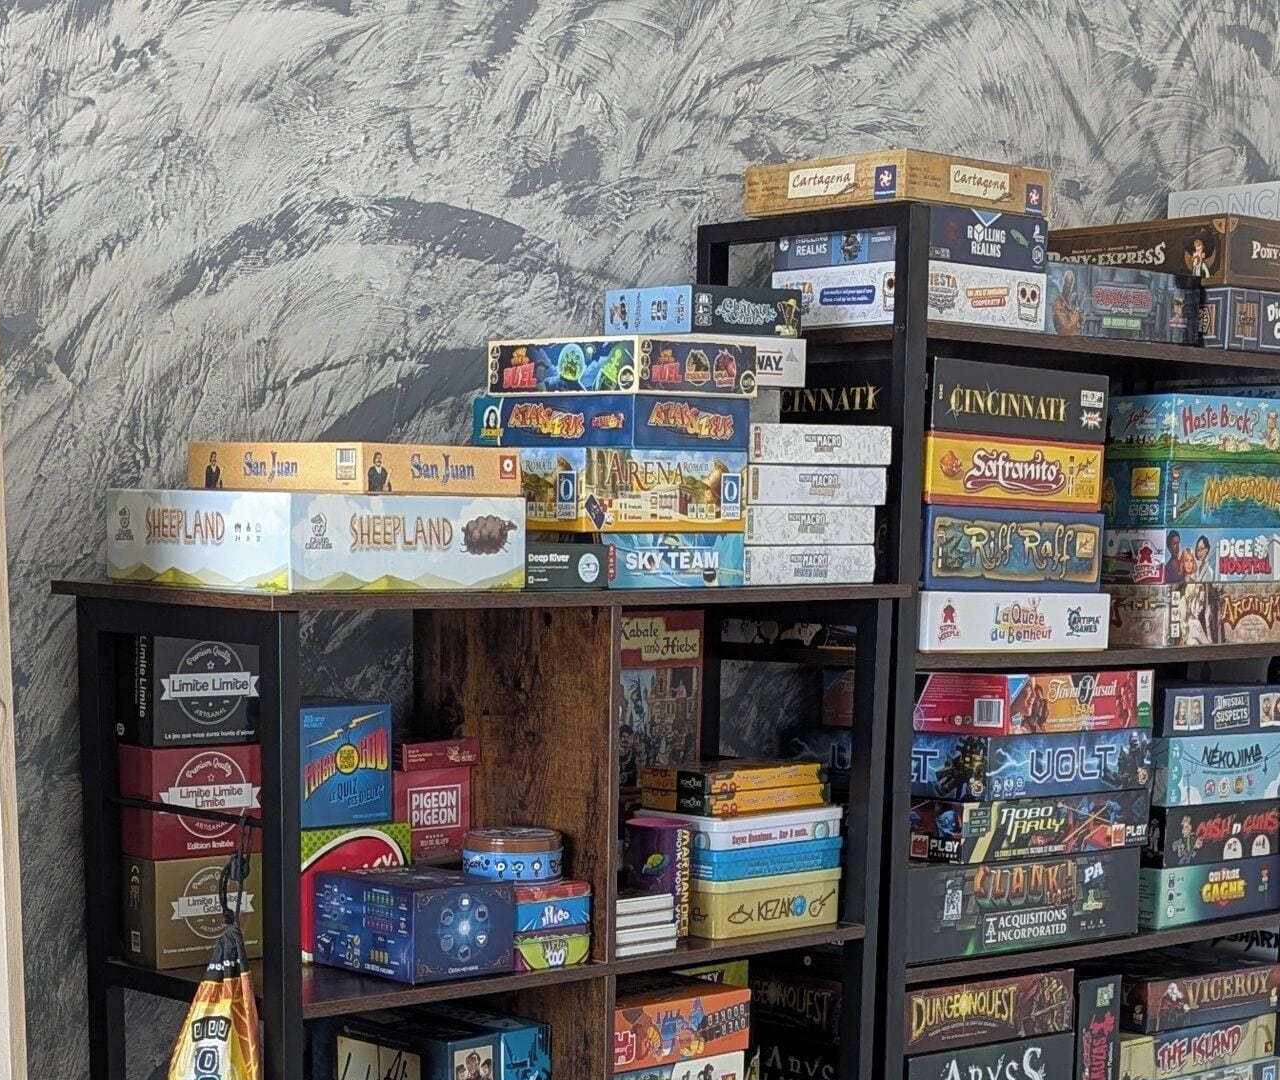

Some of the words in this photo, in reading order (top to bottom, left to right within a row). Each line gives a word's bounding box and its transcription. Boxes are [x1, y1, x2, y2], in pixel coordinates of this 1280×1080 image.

[792, 171, 852, 194] Cartagena
[952, 169, 1008, 193] Cartagena
[796, 243, 828, 256] REALMS
[970, 241, 1002, 258] REALMS
[503, 362, 537, 389] DUEL
[950, 387, 1070, 423] CINCINNATI
[1181, 406, 1218, 434] Haste
[1220, 407, 1260, 437] Bock?
[817, 434, 842, 448] MACRO
[244, 450, 269, 479] San
[269, 450, 299, 480] Juan
[410, 452, 439, 480] San
[439, 452, 476, 486] Juan
[525, 460, 546, 473] ROMA
[606, 451, 687, 492] ARENA
[683, 461, 703, 473] ROMA
[972, 448, 1062, 486] Safranito
[812, 474, 838, 488] MACRO
[145, 507, 226, 548] SHEEPLAND
[800, 513, 826, 526] MACRO
[350, 512, 453, 554] SHEEPLAND
[528, 552, 548, 564] Deep
[549, 552, 570, 563] River
[968, 522, 1012, 571] Riff
[1018, 520, 1075, 578] Raff
[1220, 537, 1255, 558] DICE
[626, 551, 663, 570] SKY
[668, 551, 720, 569] TEAM
[802, 554, 829, 567] MACRO
[994, 603, 1010, 627] La
[620, 621, 660, 641] Kabale
[991, 627, 1006, 642] du
[1006, 623, 1053, 643] Bonheur
[1073, 622, 1099, 634] GAMES
[644, 638, 660, 655] und
[661, 636, 698, 656] Hiebe
[139, 635, 147, 679] Limite
[171, 678, 210, 693] Limite
[211, 677, 250, 692] Limite
[139, 679, 148, 719] Limite
[1215, 707, 1249, 723] SUSPECTS
[1029, 744, 1117, 784] VOLT
[179, 787, 209, 799] Limite
[211, 786, 243, 797] Limite
[337, 778, 358, 801] QUIZ
[195, 797, 226, 807] Limite
[411, 792, 457, 810] PIGEON
[411, 808, 457, 826] PIGEON
[1000, 806, 1053, 828] ROBO
[1011, 817, 1066, 843] RALLY
[1125, 824, 1148, 838] PLAY
[187, 839, 209, 850] Edition
[210, 838, 234, 849] limitée
[929, 838, 960, 853] PLAY
[680, 829, 691, 904] MARTIAN
[187, 894, 212, 907] Limite
[1202, 881, 1248, 903] GAGNE
[756, 895, 807, 922] KEZAKO
[998, 908, 1068, 929] ACQUISITIONS
[680, 903, 690, 936] DICE
[997, 922, 1067, 943] INCORPORATED
[1183, 971, 1270, 1010] VICEROY
[706, 1001, 746, 1022] BOOKED
[909, 985, 1019, 1047] DUNGEONQUEST
[1157, 1037, 1189, 1075] THE
[1191, 1024, 1243, 1066] ISLAND
